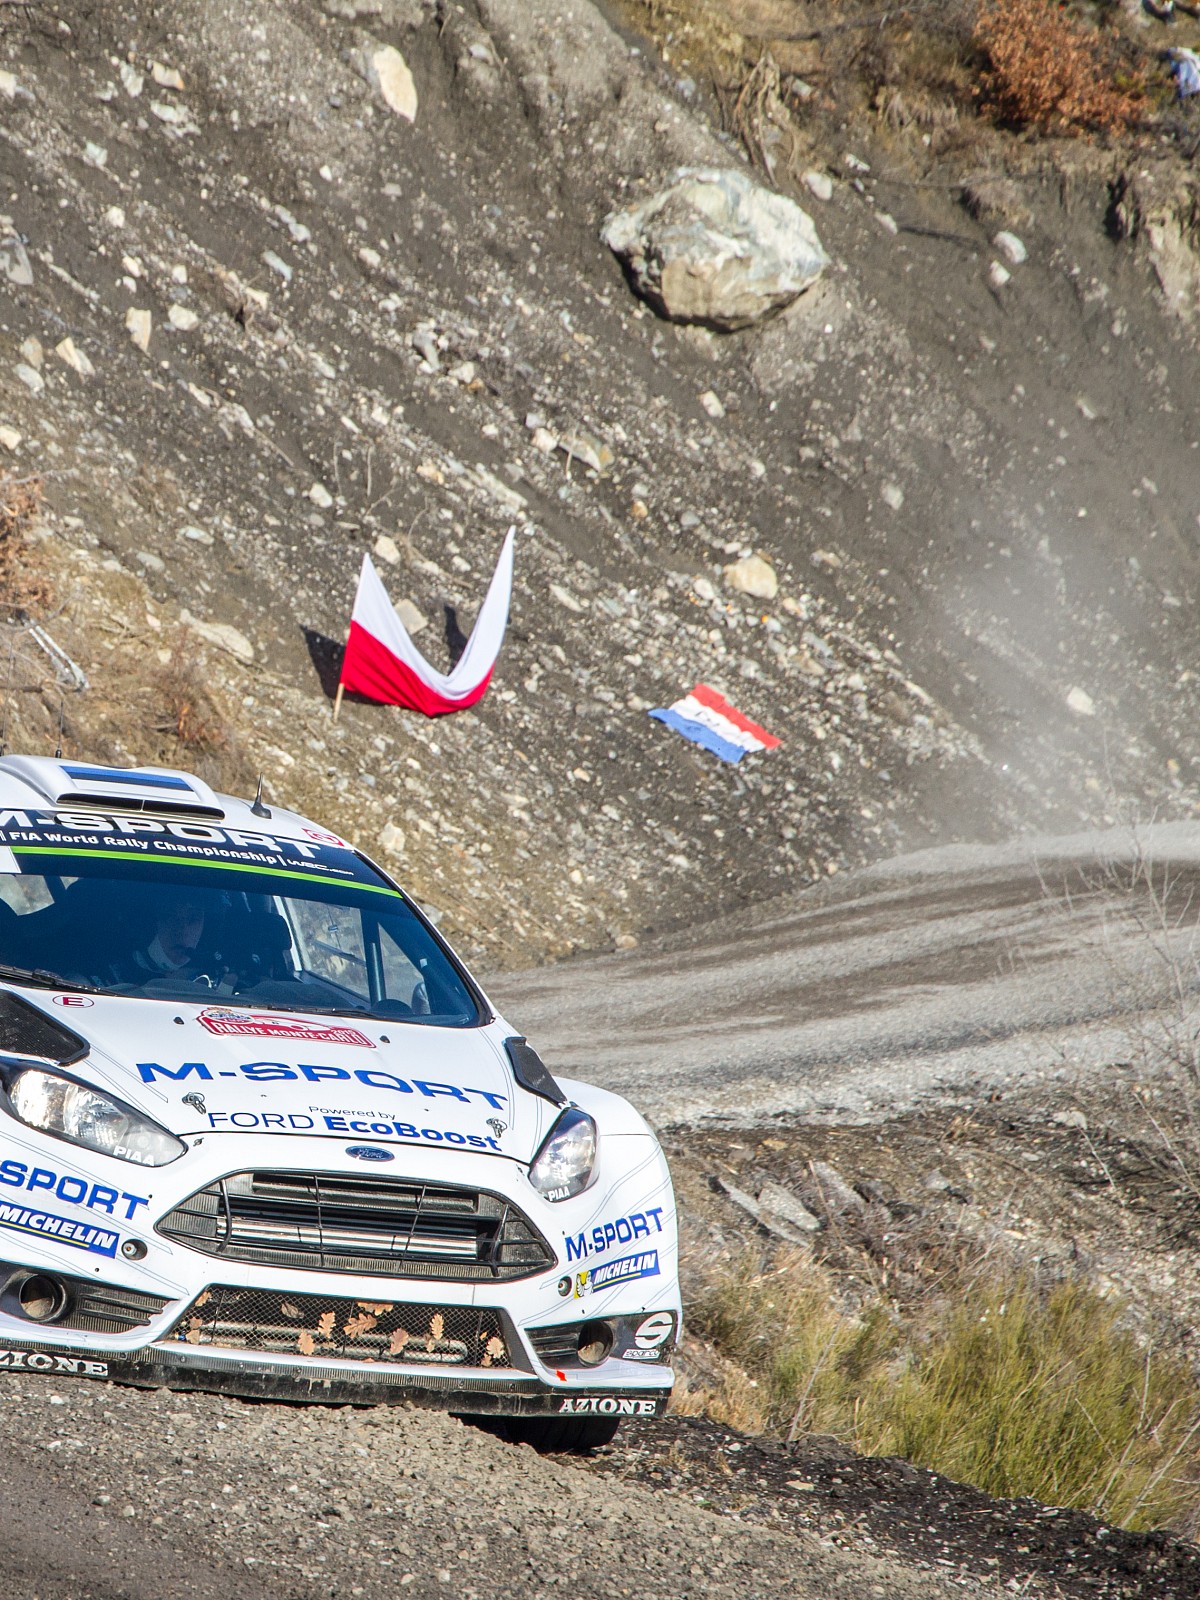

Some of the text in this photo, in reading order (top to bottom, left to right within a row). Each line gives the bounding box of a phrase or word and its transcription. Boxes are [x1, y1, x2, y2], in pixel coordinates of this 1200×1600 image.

[9, 831, 42, 842] FIA
[43, 832, 99, 845] World
[104, 835, 149, 850] Rally
[153, 839, 278, 865] Championship
[62, 996, 85, 1007] E
[210, 1022, 367, 1045] RALLYE MONTE-CARLO
[135, 1062, 509, 1111] M-SPORT
[308, 1105, 397, 1121] Powered by
[208, 1112, 503, 1152] FORD EcoBoost
[113, 1145, 155, 1167] PIAA
[547, 1186, 571, 1202] PIAA
[564, 1206, 664, 1262] M-SPORT
[593, 1252, 657, 1285] MICHELIN
[559, 1398, 657, 1415] AZIONE
